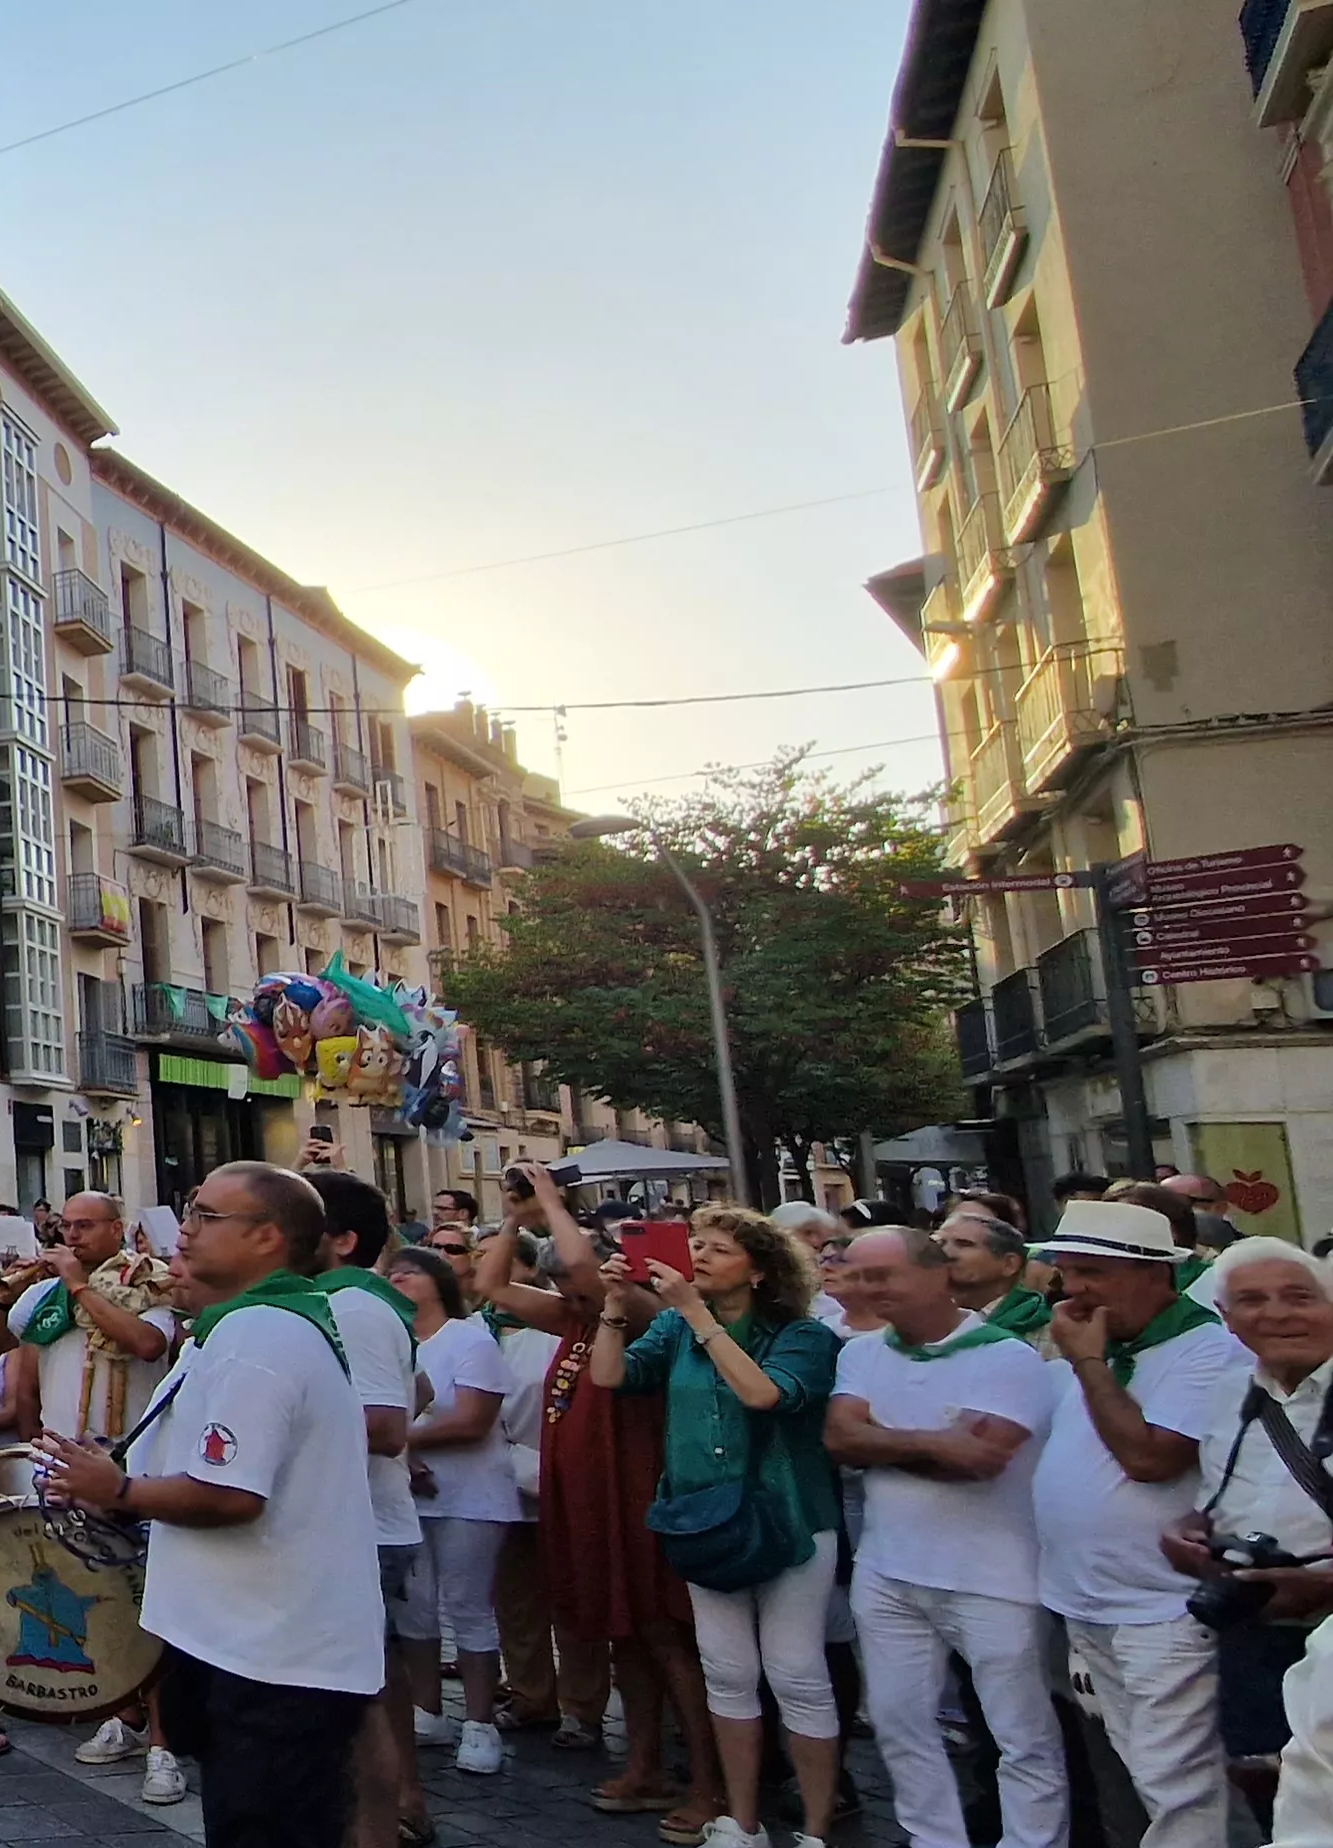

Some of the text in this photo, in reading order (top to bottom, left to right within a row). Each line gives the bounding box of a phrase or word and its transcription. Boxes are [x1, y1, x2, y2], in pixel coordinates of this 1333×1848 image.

[1185, 861, 1199, 871] de
[1200, 857, 1243, 868] Turismo
[941, 880, 990, 893] Estación
[1162, 969, 1199, 980] Centro
[5, 1673, 98, 1701] BARBASTRO
